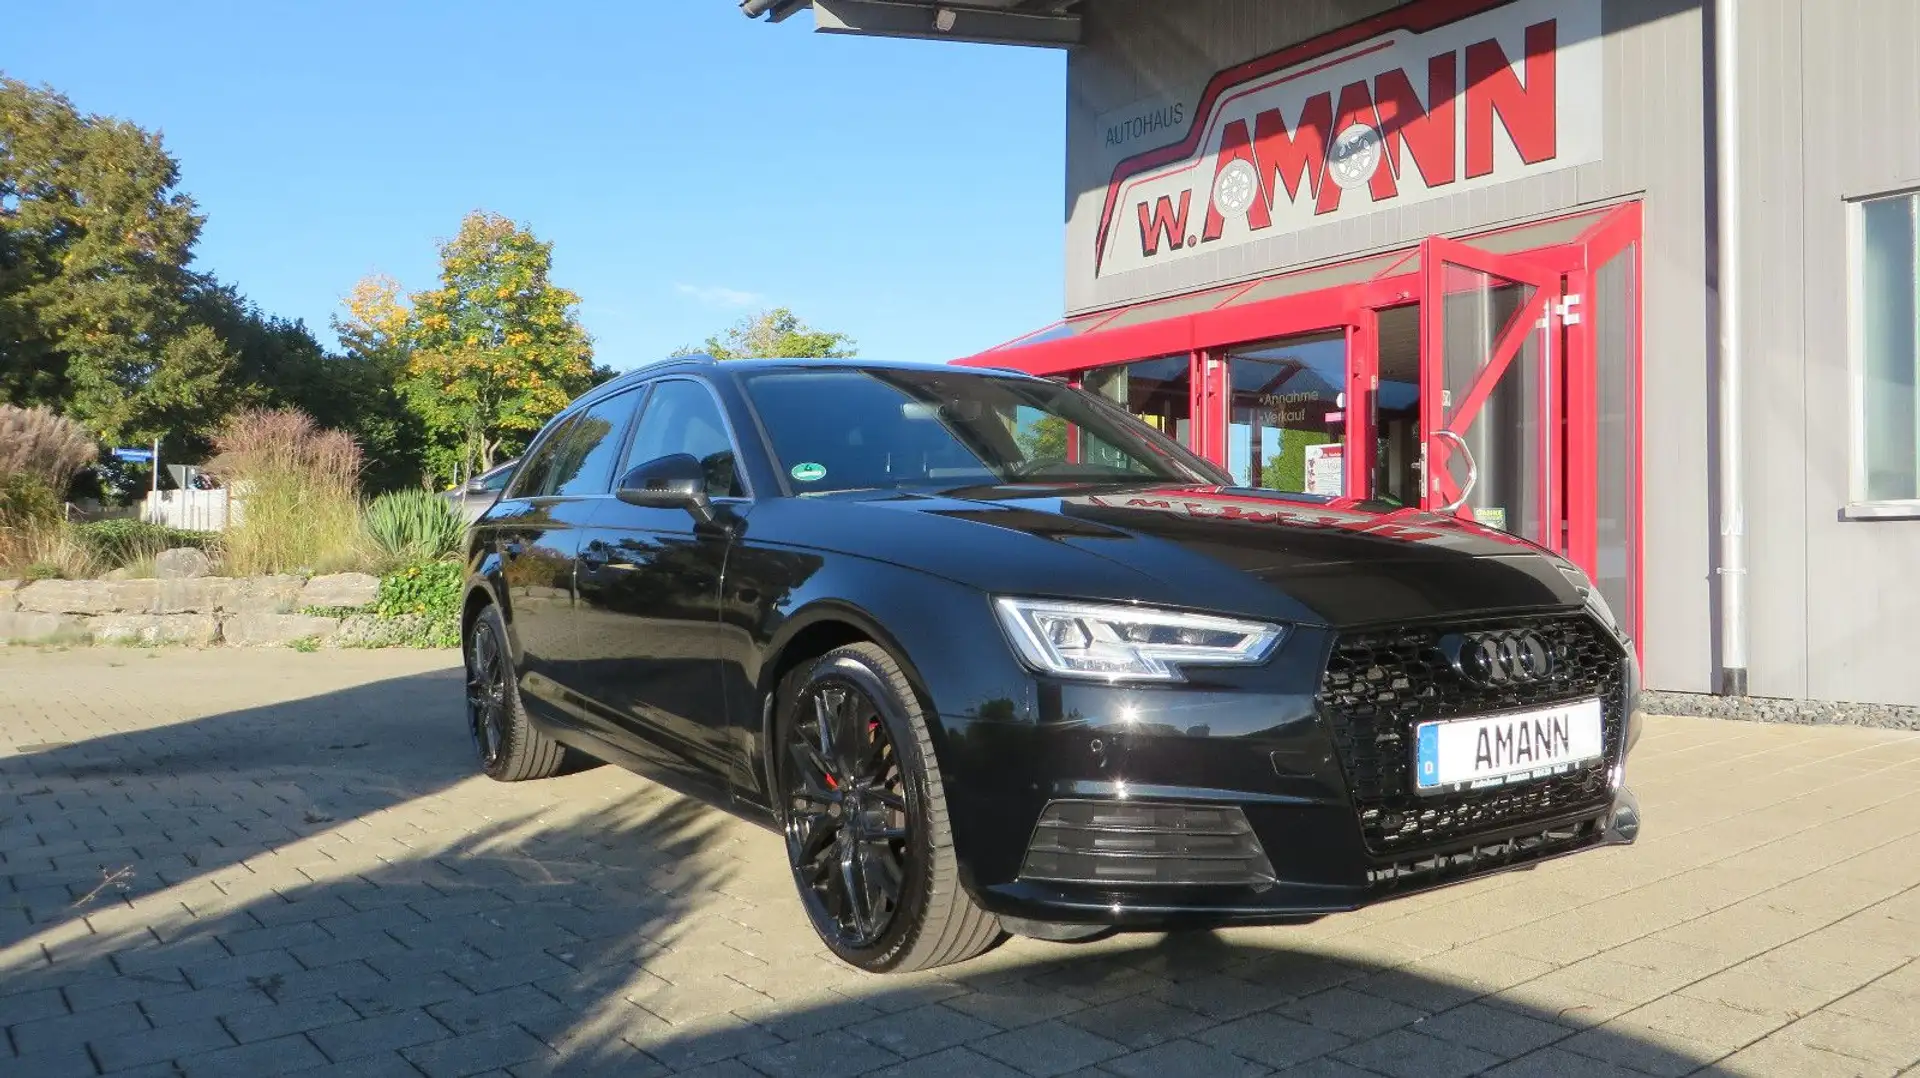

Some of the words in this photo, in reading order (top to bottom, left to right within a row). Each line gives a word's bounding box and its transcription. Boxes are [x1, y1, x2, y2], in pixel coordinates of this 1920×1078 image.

[1105, 102, 1184, 146] AUTOHAUS
[1201, 18, 1557, 241] AMANN
[1264, 390, 1319, 405] Annahme
[1264, 408, 1306, 422] Verkauf
[1475, 714, 1569, 770] AMANN
